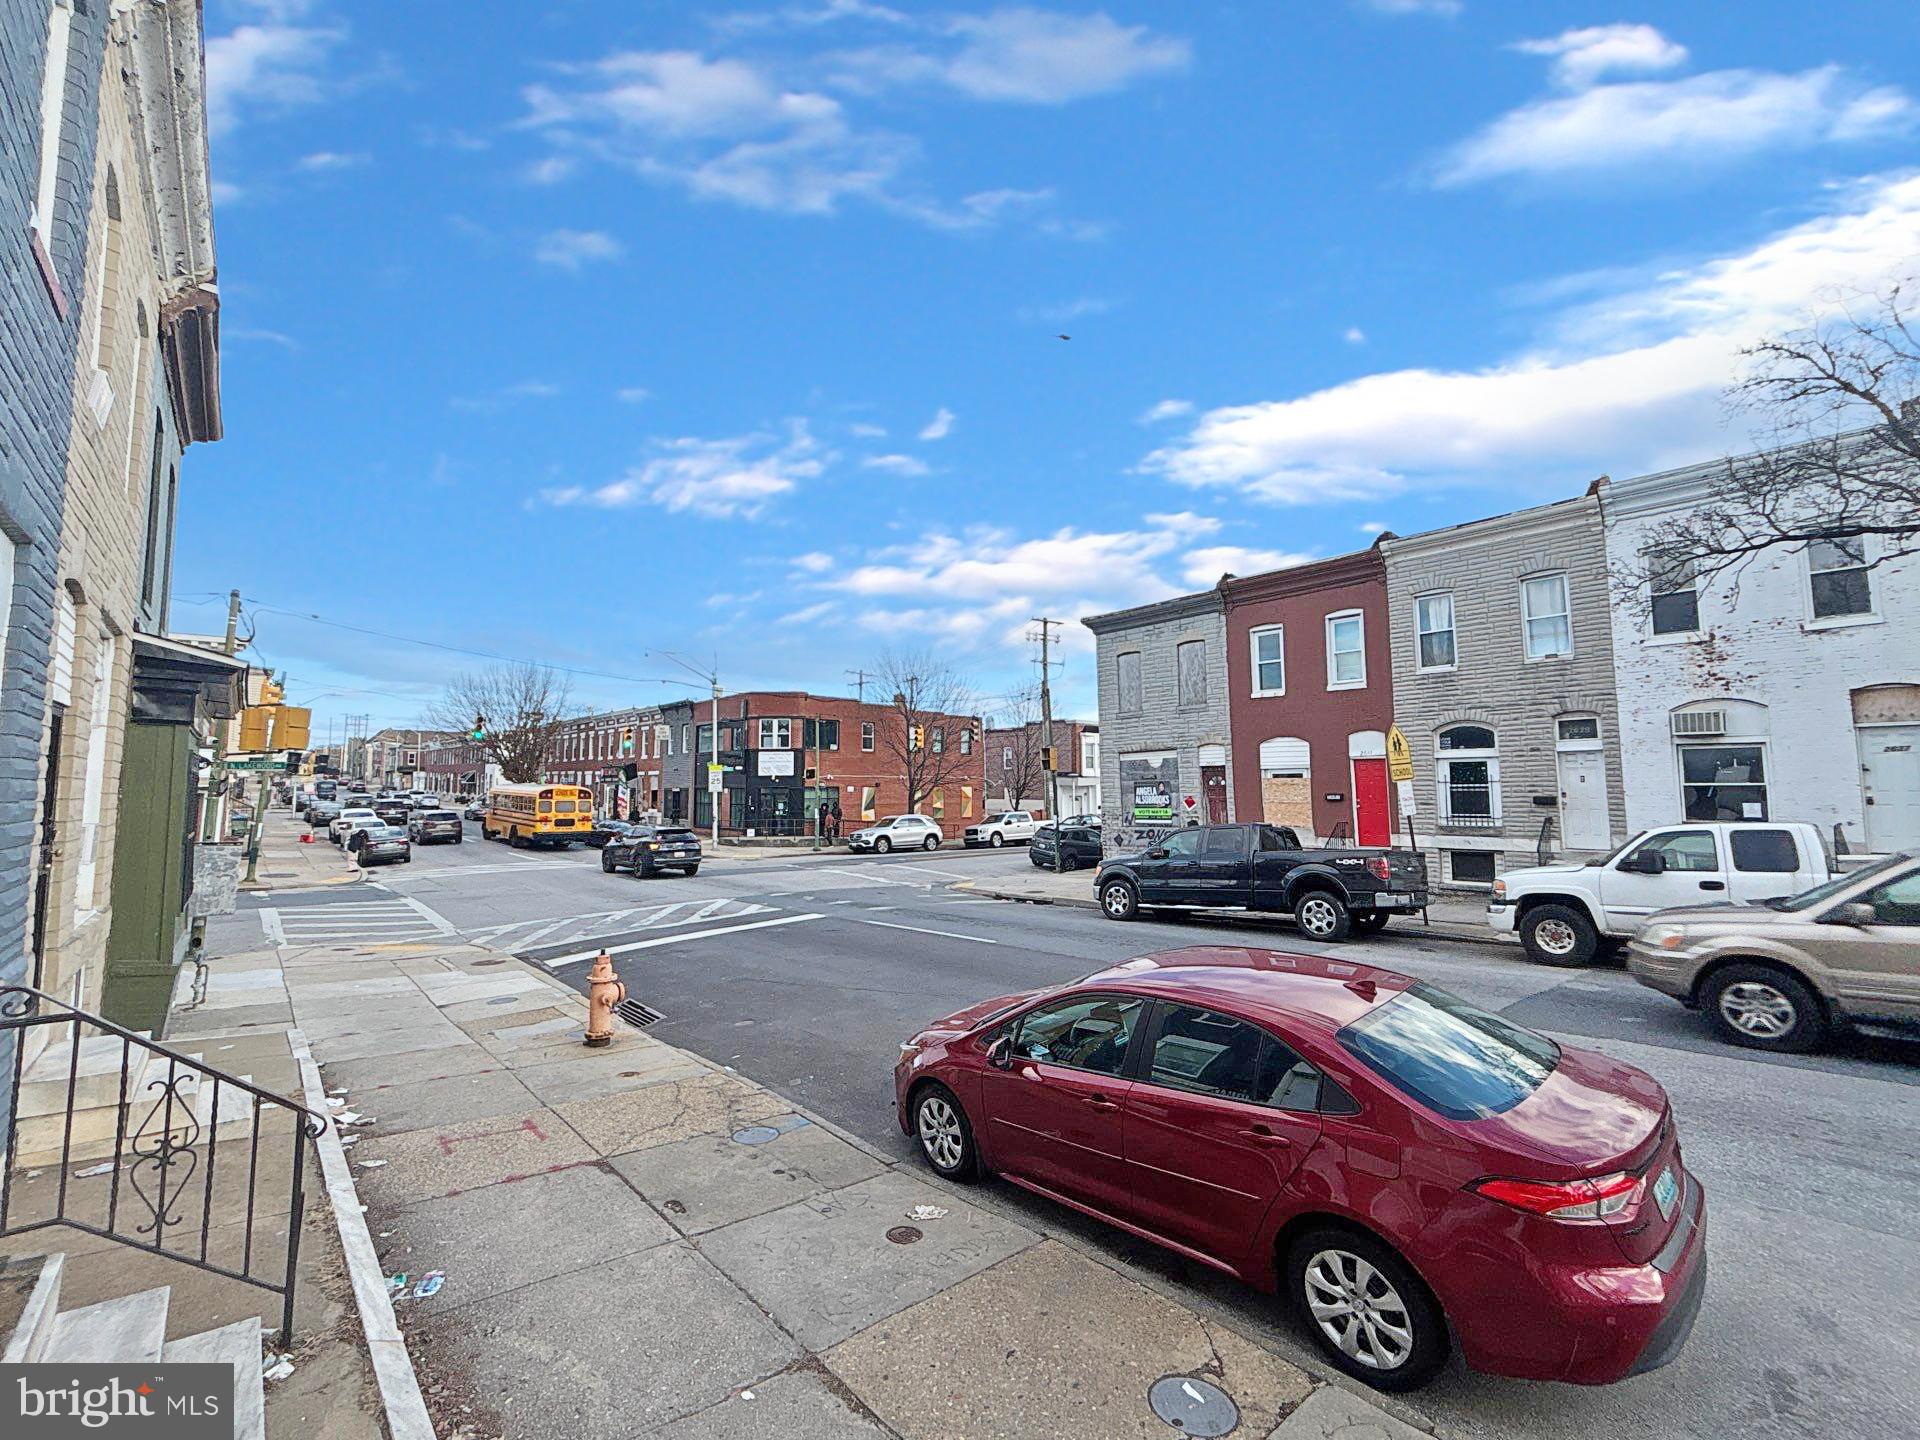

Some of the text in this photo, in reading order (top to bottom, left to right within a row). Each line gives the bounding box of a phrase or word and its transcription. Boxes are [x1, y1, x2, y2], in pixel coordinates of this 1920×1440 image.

[1392, 767, 1413, 778] SCHOOL
[710, 777, 721, 785] 25
[1136, 786, 1157, 796] ANGELA
[1136, 795, 1170, 805] ALSOBROOKS
